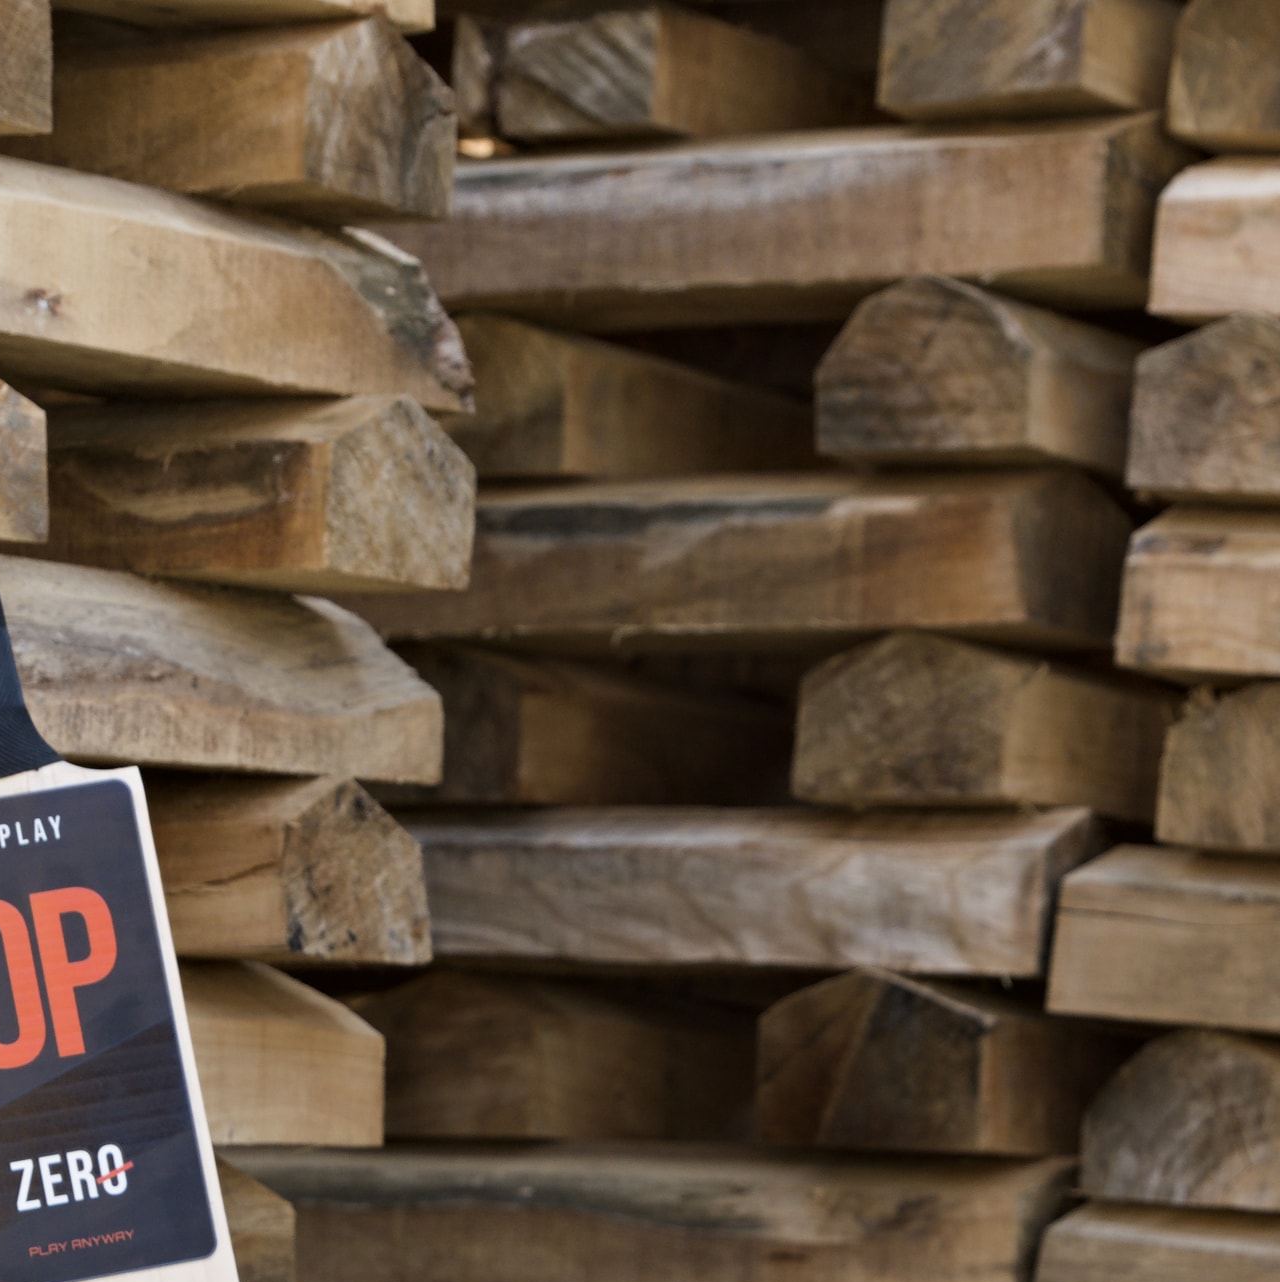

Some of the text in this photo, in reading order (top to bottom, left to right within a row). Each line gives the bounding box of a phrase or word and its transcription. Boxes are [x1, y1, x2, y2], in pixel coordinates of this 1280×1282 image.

[9, 1143, 133, 1212] ZERO
[28, 1229, 135, 1258] PLAY ANYWAY
